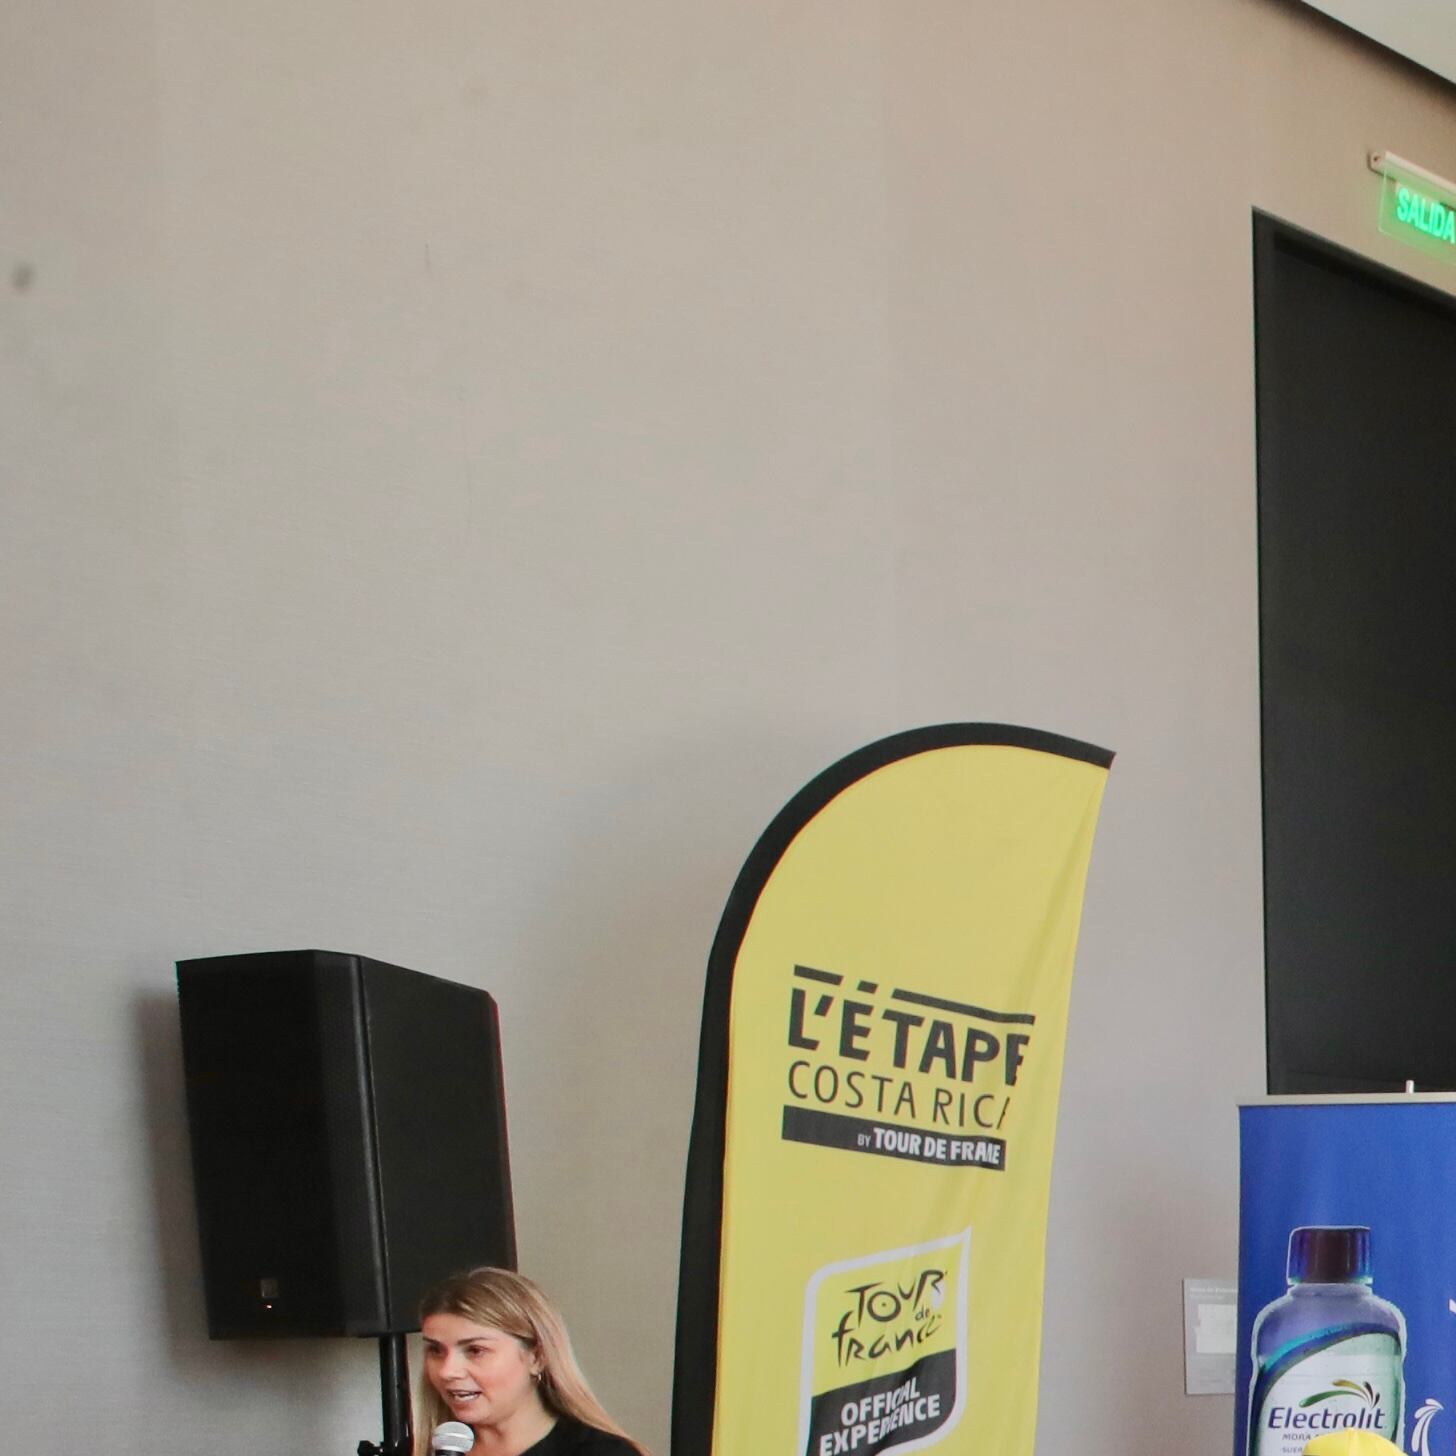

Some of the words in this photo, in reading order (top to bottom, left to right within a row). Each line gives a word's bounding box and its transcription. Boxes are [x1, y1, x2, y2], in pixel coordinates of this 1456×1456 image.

[1397, 187, 1456, 244] SALIDA
[788, 1061, 916, 1119] COSTA
[858, 1134, 871, 1147] BY
[873, 1127, 921, 1156] TOUR
[922, 1135, 946, 1159] DE
[844, 1269, 948, 1327] TOUR
[841, 1377, 920, 1427] OFFICIAL
[1268, 1407, 1385, 1430] Electrolit
